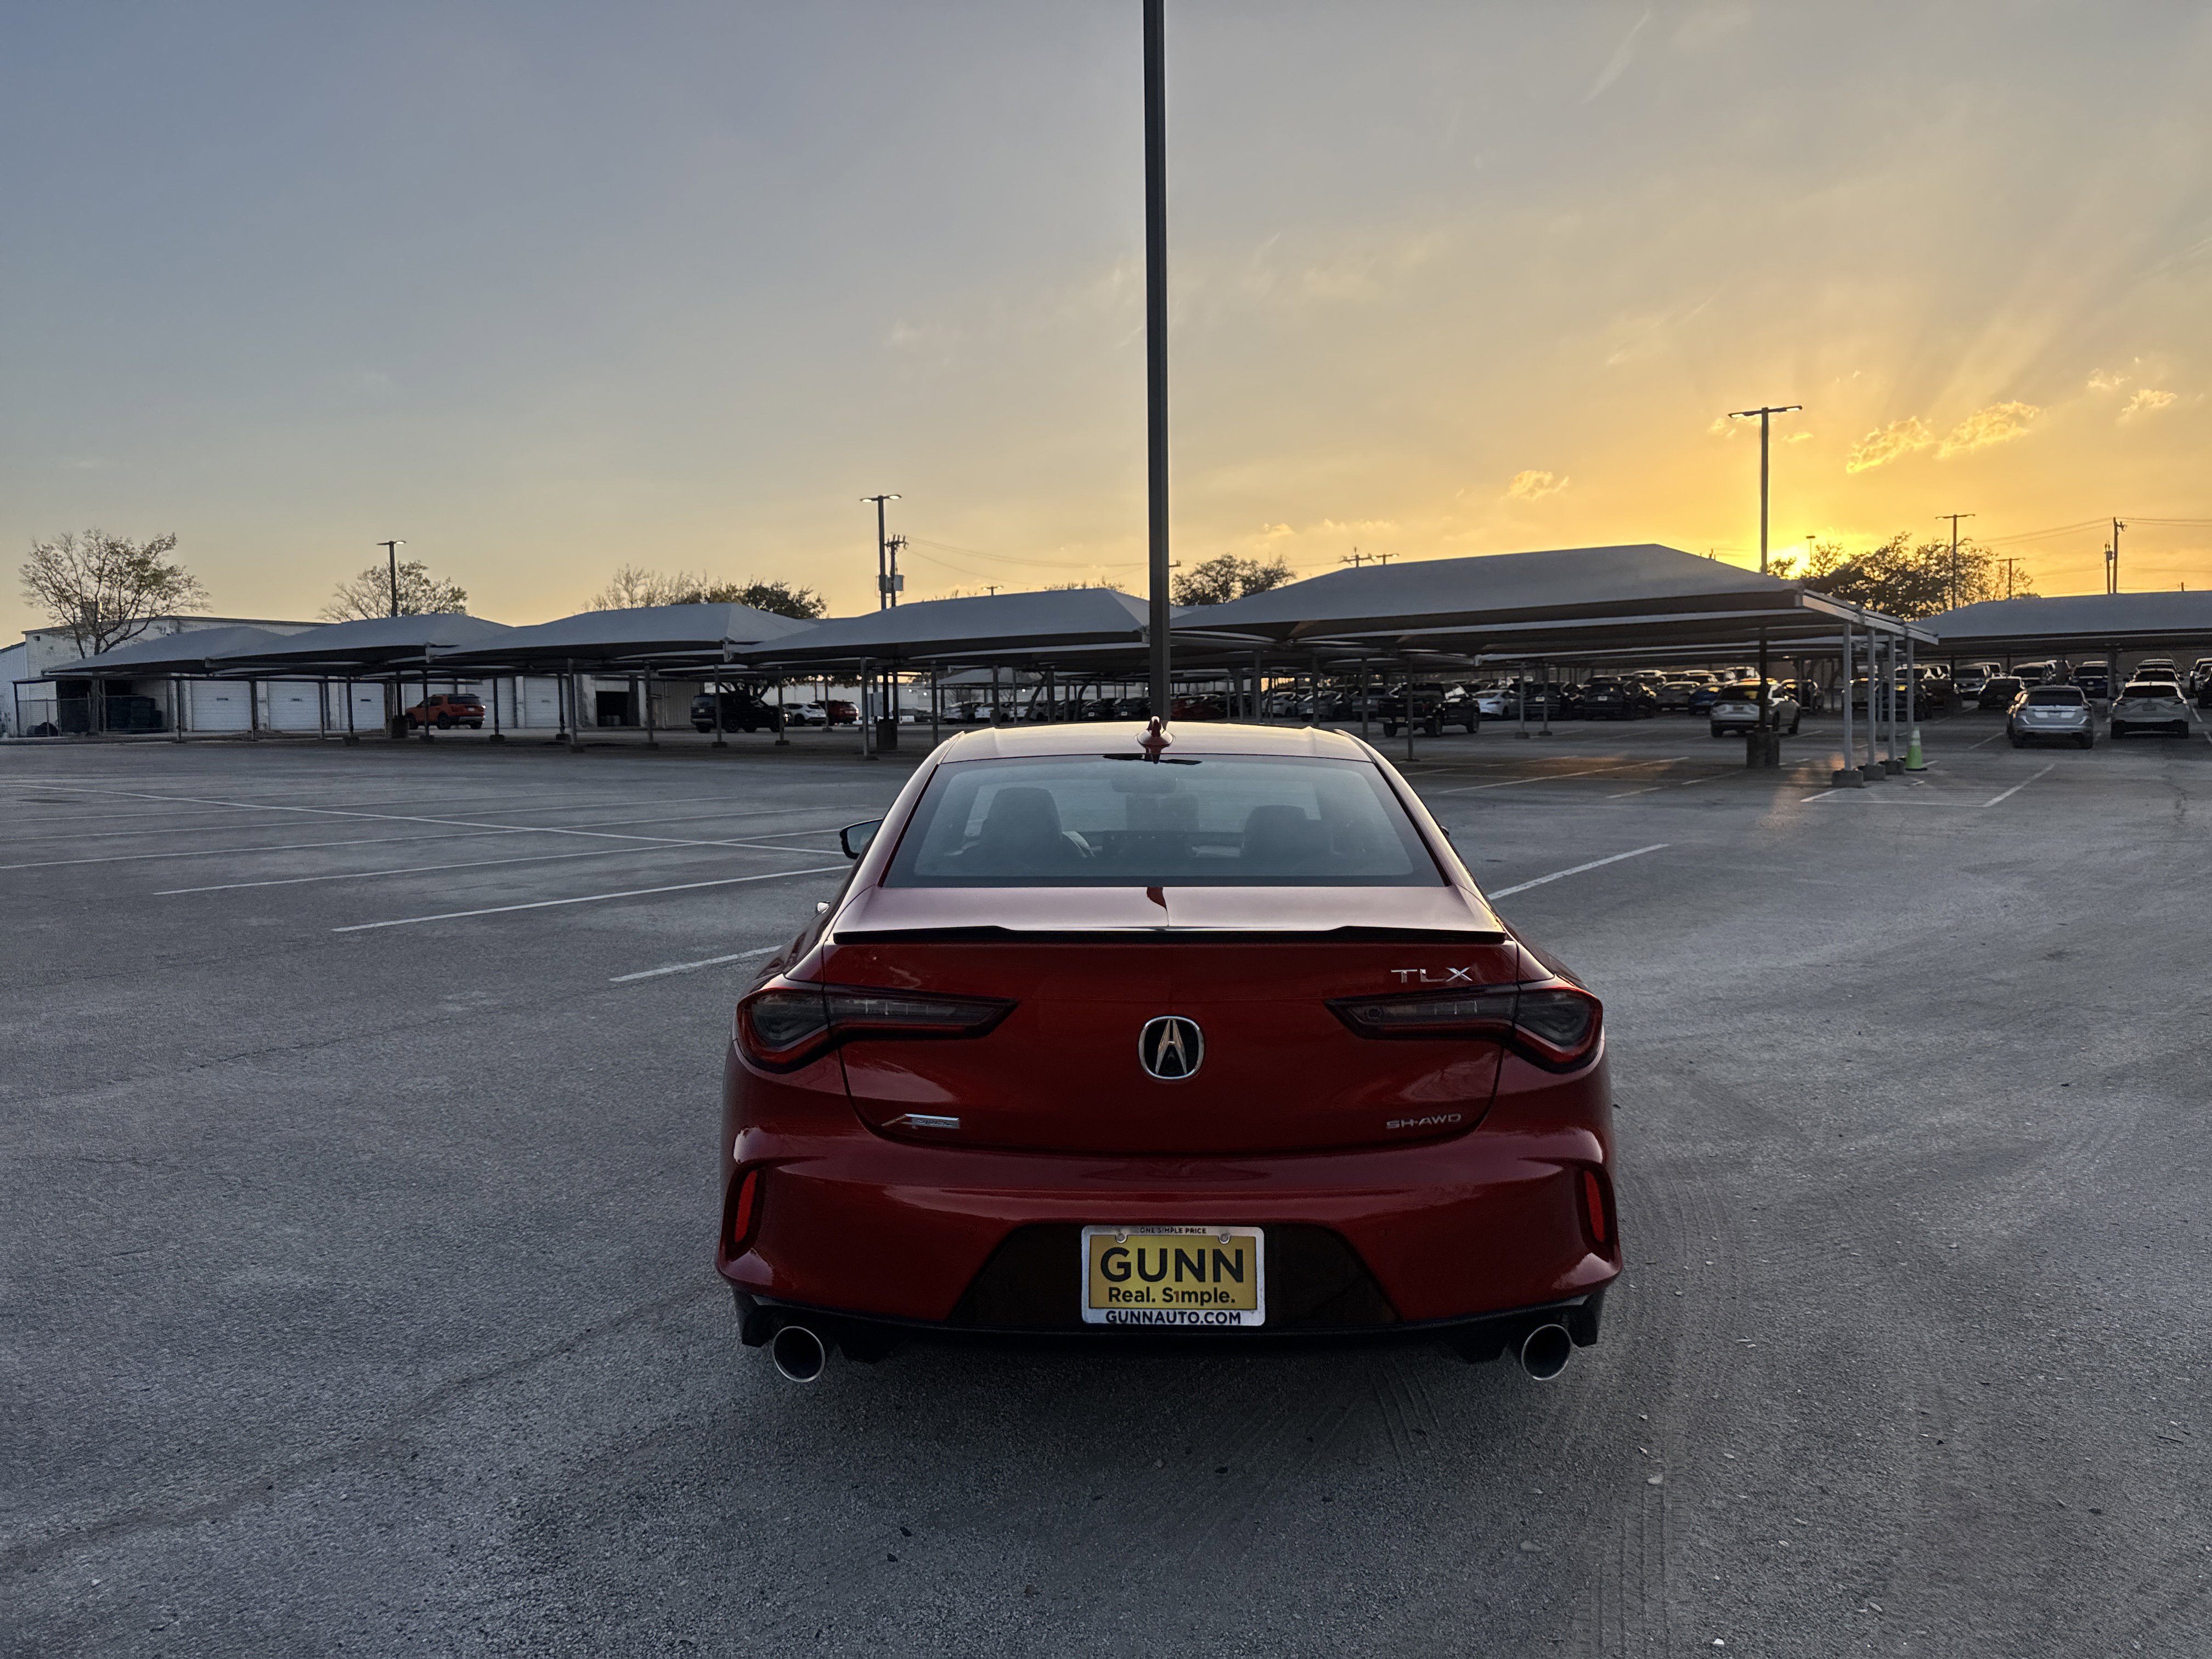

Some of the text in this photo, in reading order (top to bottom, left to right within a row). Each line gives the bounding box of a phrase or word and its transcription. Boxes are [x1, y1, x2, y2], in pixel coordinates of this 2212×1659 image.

[1391, 967, 1472, 983] TLX
[1101, 1247, 1244, 1283] GUNN
[1109, 1286, 1156, 1302] Real.
[1105, 1310, 1241, 1324] GUNNAUTO.COM
